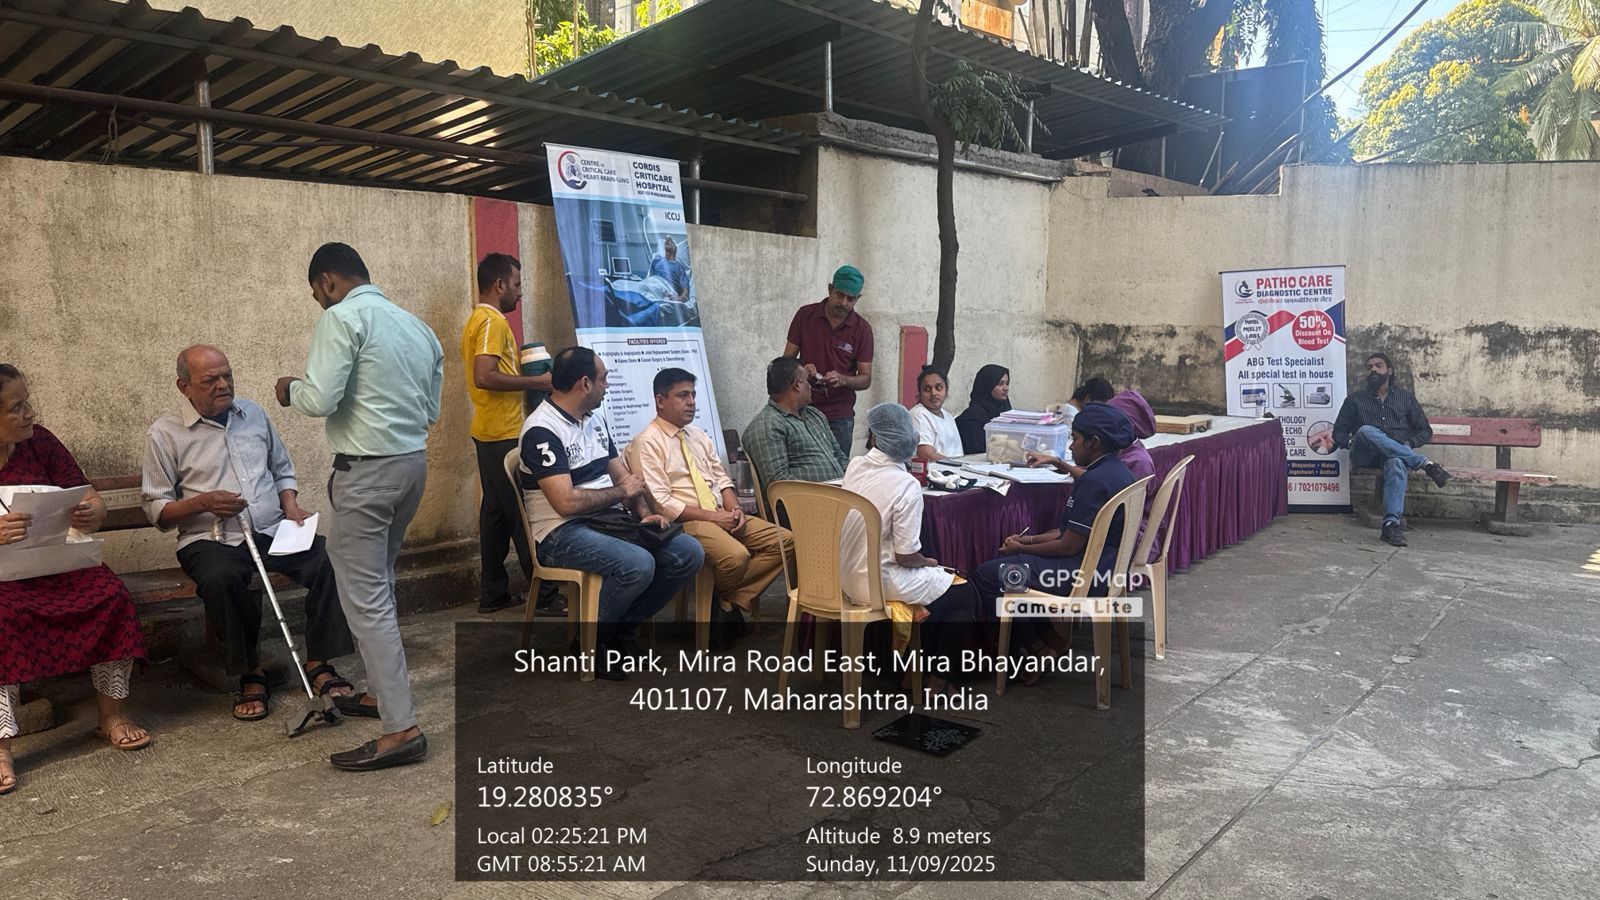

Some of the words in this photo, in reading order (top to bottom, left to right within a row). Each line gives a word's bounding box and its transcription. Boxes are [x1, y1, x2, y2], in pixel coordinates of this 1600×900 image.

[582, 166, 603, 174] CRITICAL
[633, 162, 660, 172] CORDIS
[634, 172, 673, 183] CRITICARE
[636, 182, 671, 192] HOSPITAL
[665, 211, 680, 221] ICCU
[1256, 276, 1297, 289] PATHO
[1299, 275, 1333, 288] CARE
[1256, 289, 1301, 298] DIAGNOSTIC
[1303, 288, 1333, 296] CENTRE
[1300, 315, 1327, 328] 50%
[1247, 357, 1264, 366] ABG
[1266, 357, 1282, 366] Test
[1284, 357, 1324, 368] Specialist
[1238, 371, 1249, 379] All
[1251, 370, 1280, 380] special
[1282, 370, 1297, 379] test
[1299, 370, 1306, 379] in
[1308, 370, 1334, 379] house
[1285, 426, 1302, 434] ECHO
[536, 442, 556, 467] 3
